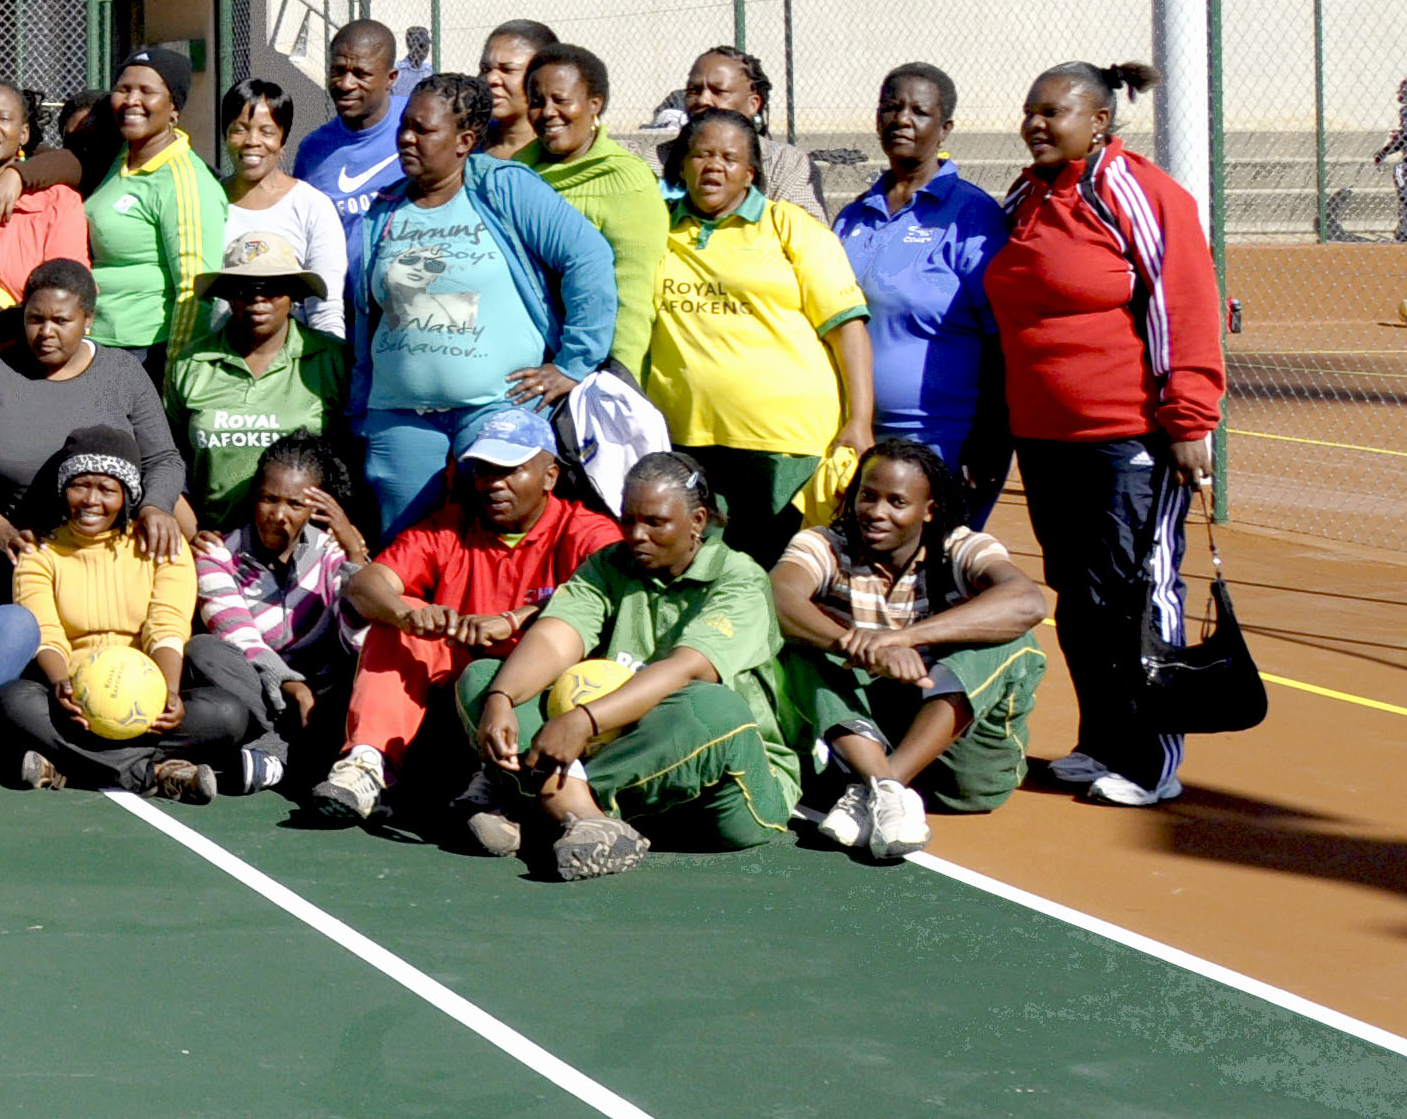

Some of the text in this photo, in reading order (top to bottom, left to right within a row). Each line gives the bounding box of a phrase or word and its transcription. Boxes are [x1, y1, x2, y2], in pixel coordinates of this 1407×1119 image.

[662, 278, 727, 297] ROYAL
[658, 299, 754, 315] AFOKENG
[214, 411, 279, 430] ROYAL
[197, 430, 287, 450] BAFOKEN
